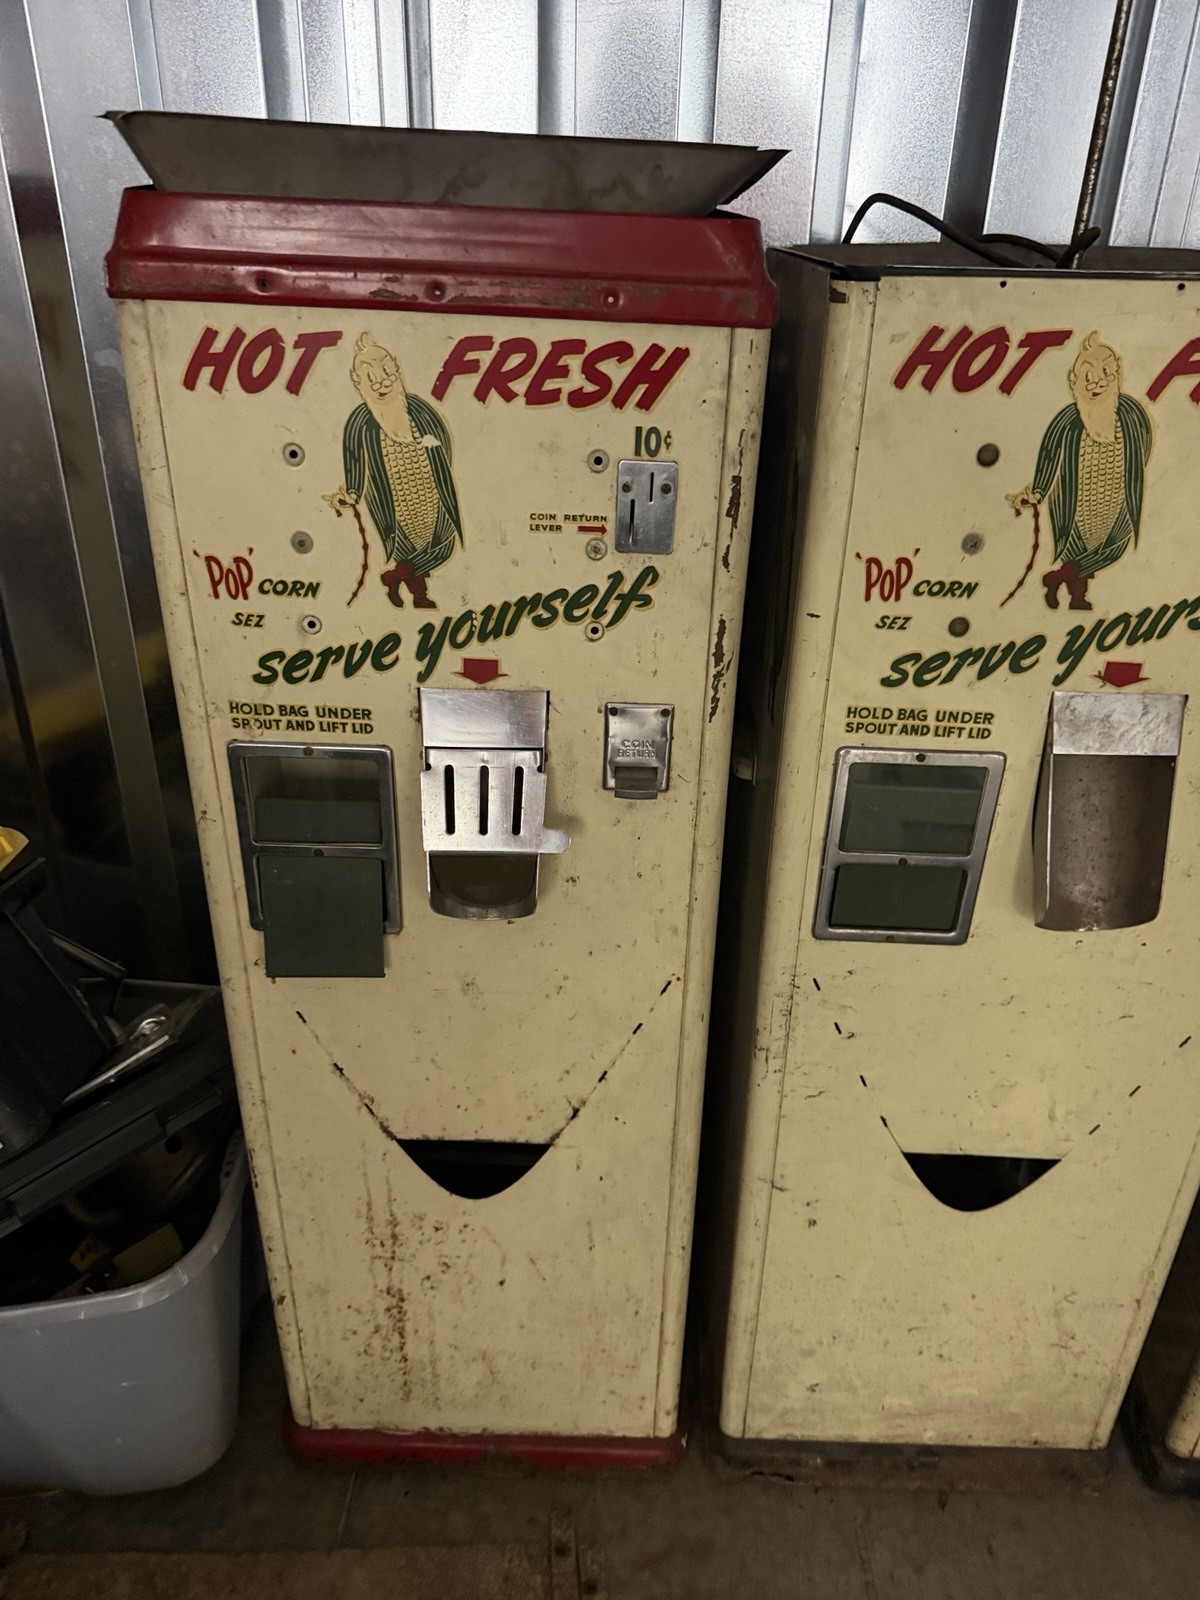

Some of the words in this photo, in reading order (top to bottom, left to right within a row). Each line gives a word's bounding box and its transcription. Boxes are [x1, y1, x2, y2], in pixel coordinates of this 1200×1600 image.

[182, 326, 343, 397] HOT
[430, 335, 691, 412] FRESH
[893, 325, 1073, 396] HOT
[1146, 337, 1200, 405] F
[634, 425, 673, 458] 10¢
[529, 513, 557, 521] COIN
[563, 513, 608, 523] RETURN
[529, 523, 562, 532] LEVER
[258, 578, 321, 598] CORN
[912, 579, 979, 598] CORN
[231, 612, 266, 628] SEZ
[252, 632, 402, 685] serve
[415, 565, 660, 683] yourself
[875, 615, 913, 630] SEZ
[880, 634, 1048, 688] serve
[229, 701, 274, 716] HOLD
[278, 704, 309, 717] BAG
[315, 706, 372, 720] UNDER
[846, 706, 893, 720] HOLD
[897, 708, 928, 721] BAG
[935, 710, 994, 725] UNDER
[232, 717, 282, 730] SPOUT
[285, 719, 316, 731] AND
[319, 721, 349, 733] LIFT
[351, 722, 374, 734] LID
[845, 721, 897, 735] SPOUT
[898, 723, 931, 736] AND
[933, 725, 965, 738] LIFT
[967, 727, 992, 739] LID
[620, 739, 655, 748] COIN
[617, 748, 657, 759] RETURN
